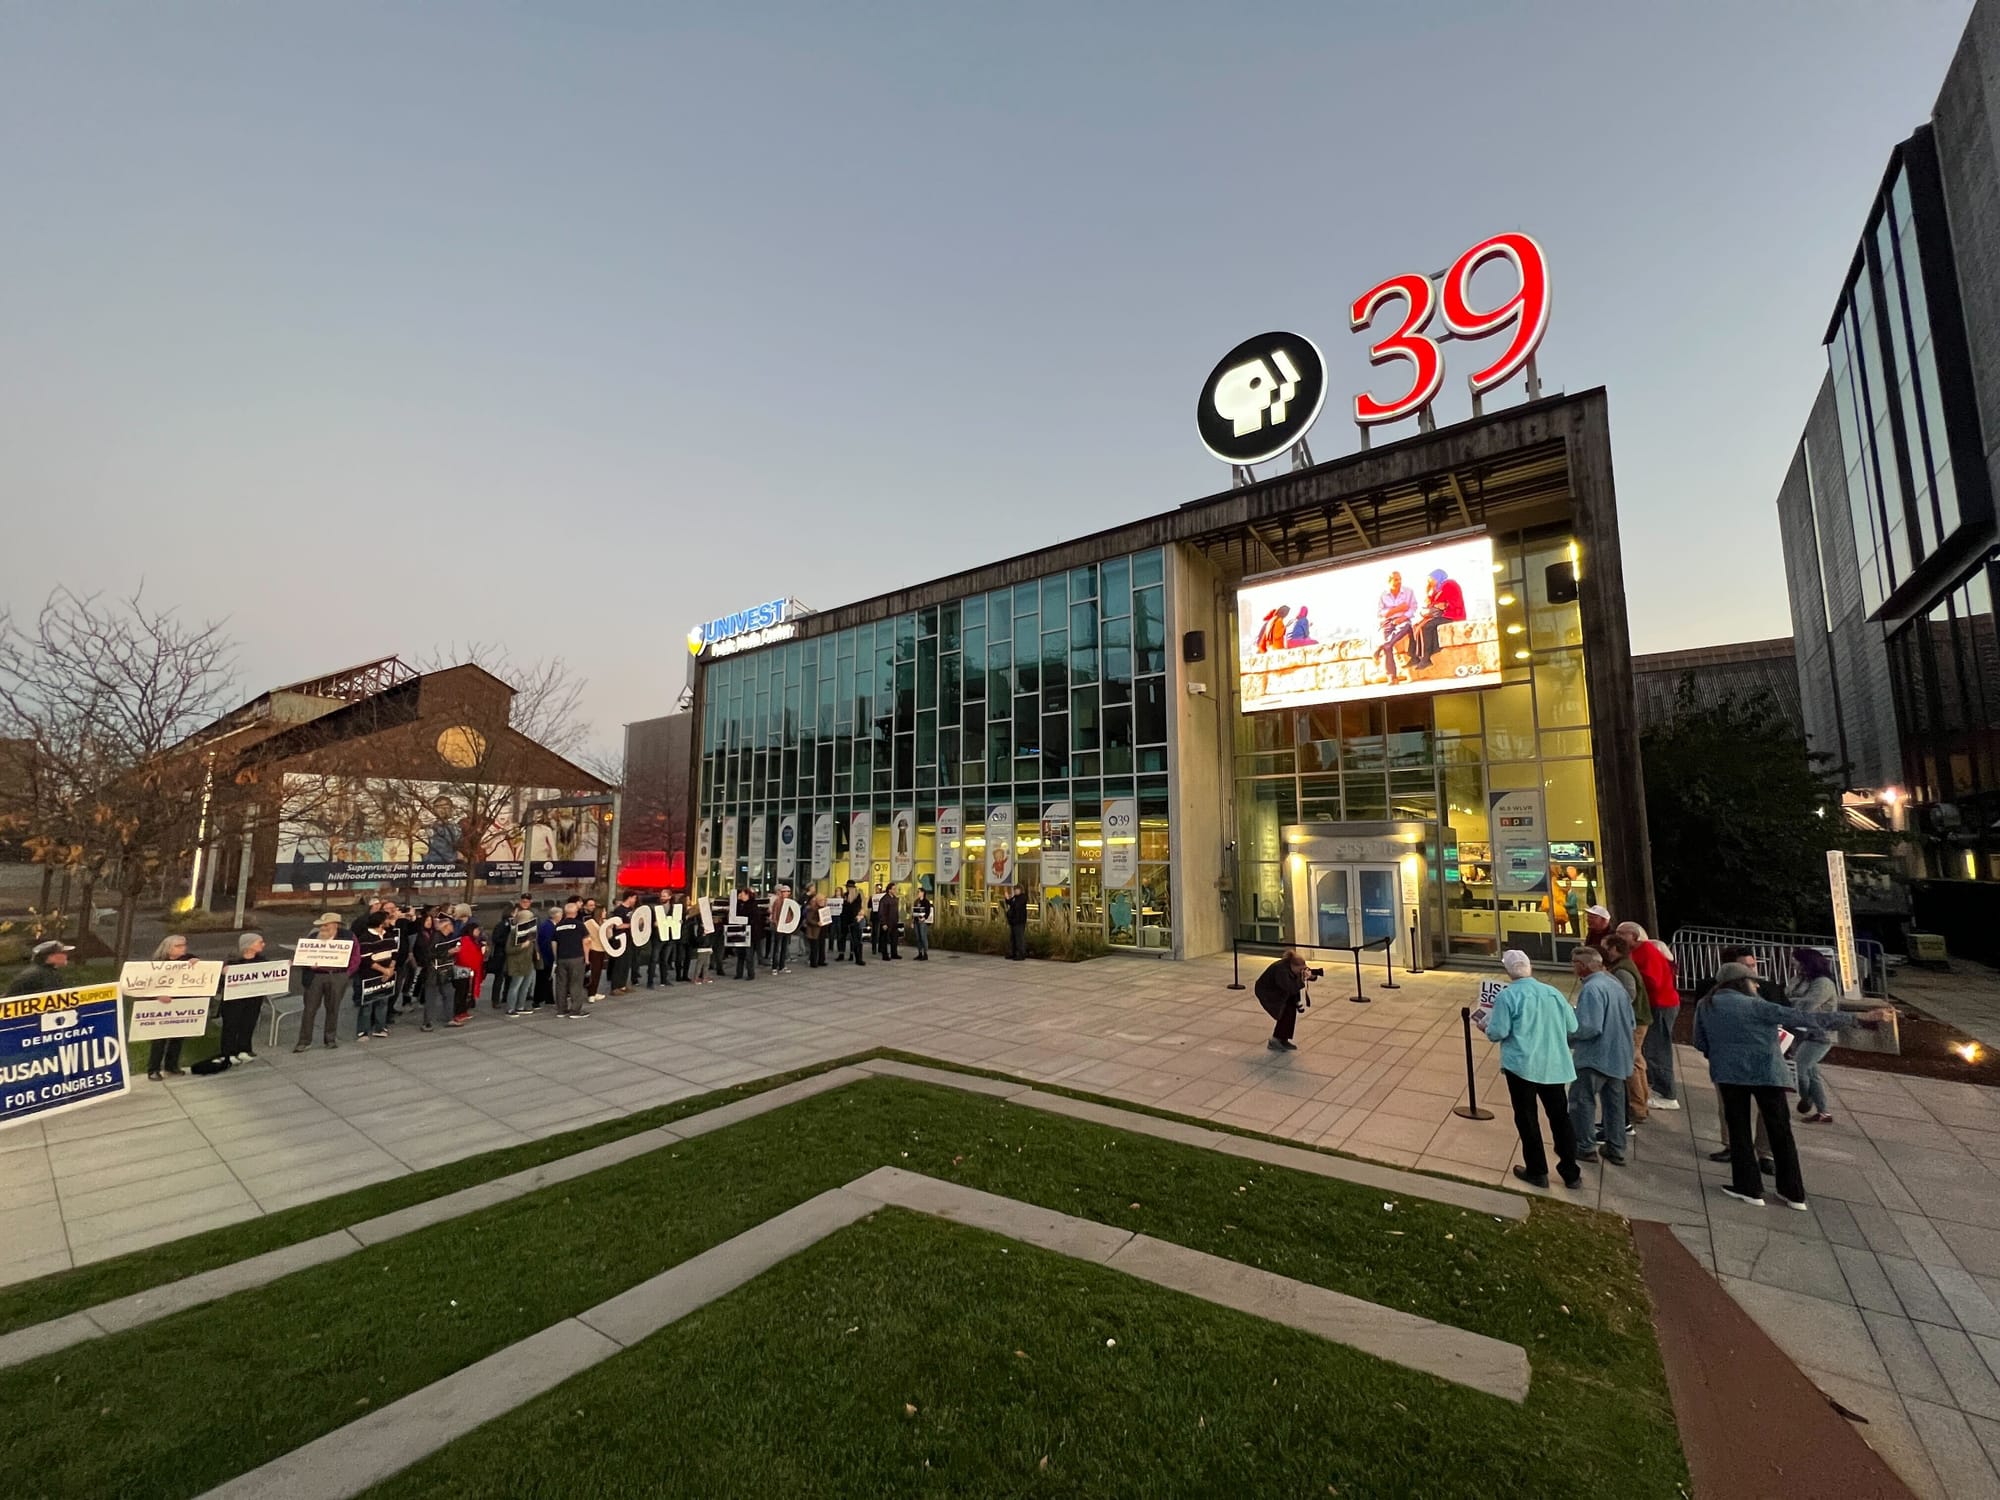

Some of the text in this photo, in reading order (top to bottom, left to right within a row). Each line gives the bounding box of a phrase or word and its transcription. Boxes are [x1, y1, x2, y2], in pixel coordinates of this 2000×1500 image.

[1349, 231, 1552, 427] 39
[704, 598, 787, 643] UNIVEST
[1117, 815, 1130, 826] 39
[227, 969, 288, 983] SUSAN WILD
[80, 989, 114, 1001] SUPPORT
[135, 1009, 206, 1019] SUSAN WILD
[22, 1026, 95, 1047] DEMOCRAT
[58, 1036, 120, 1076] WILD
[5, 1071, 113, 1109] FOR CONGRESS
